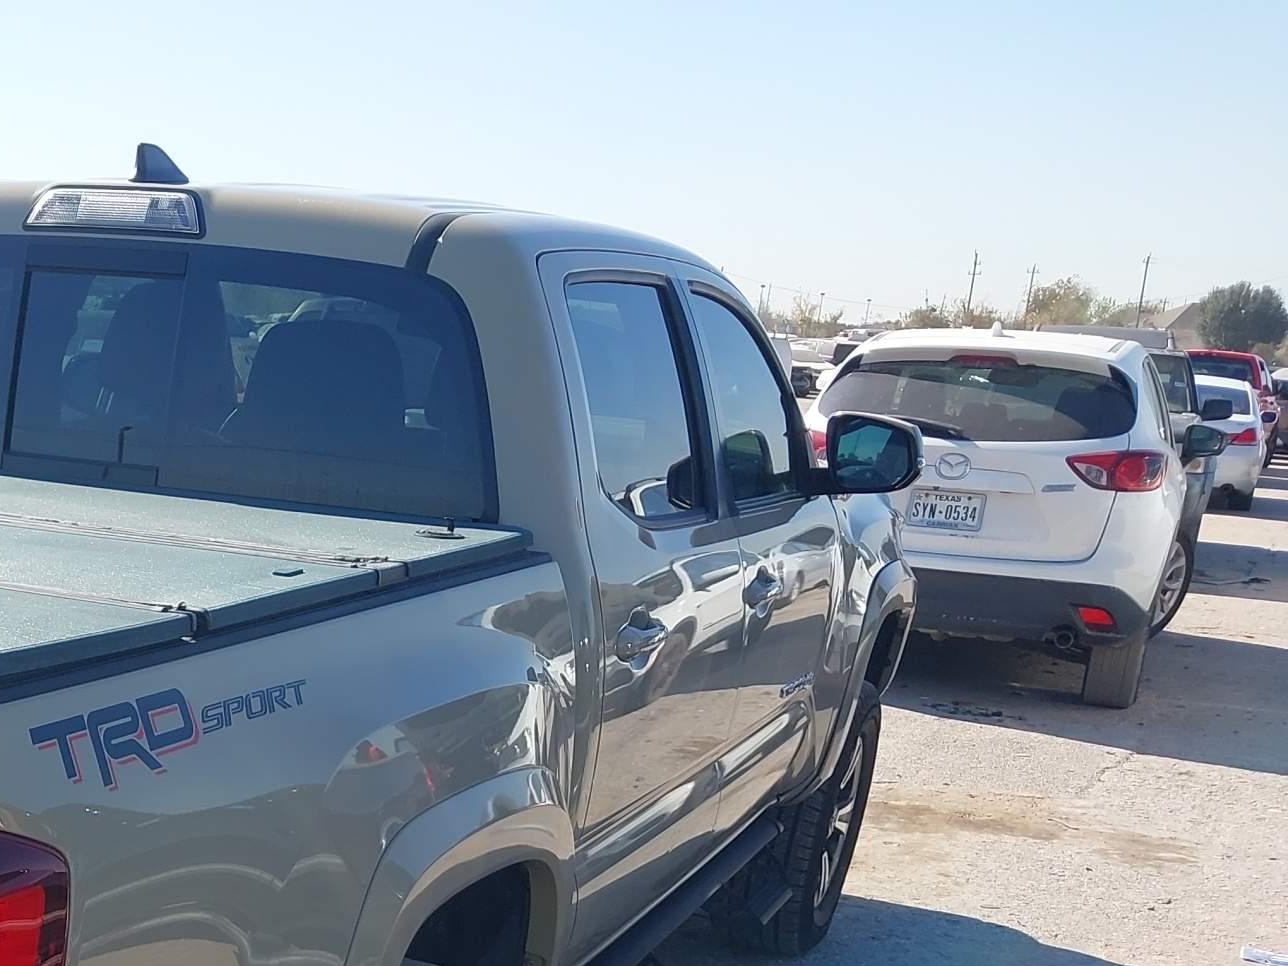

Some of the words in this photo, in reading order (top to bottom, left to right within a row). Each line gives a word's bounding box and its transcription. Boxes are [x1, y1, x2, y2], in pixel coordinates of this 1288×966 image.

[934, 494, 962, 503] TEXAS
[29, 688, 200, 791] TRD
[201, 679, 307, 735] SPORT
